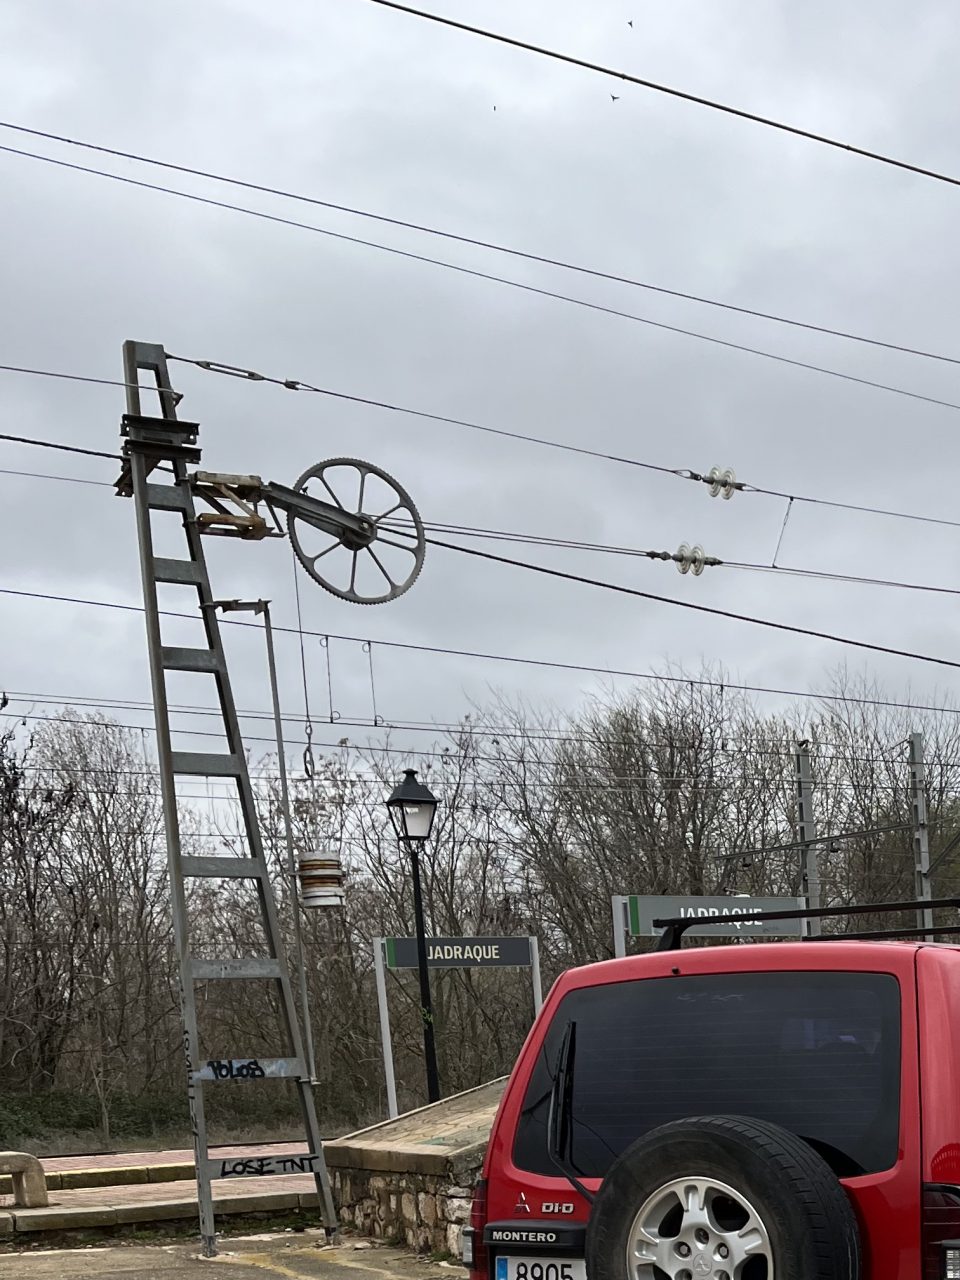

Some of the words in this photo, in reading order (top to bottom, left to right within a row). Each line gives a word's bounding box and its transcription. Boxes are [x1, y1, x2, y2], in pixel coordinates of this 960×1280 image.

[427, 945, 500, 962] JADRAQUE
[220, 1157, 275, 1177] LOSE
[276, 1156, 319, 1173] TNT
[492, 1231, 557, 1243] MONTERO
